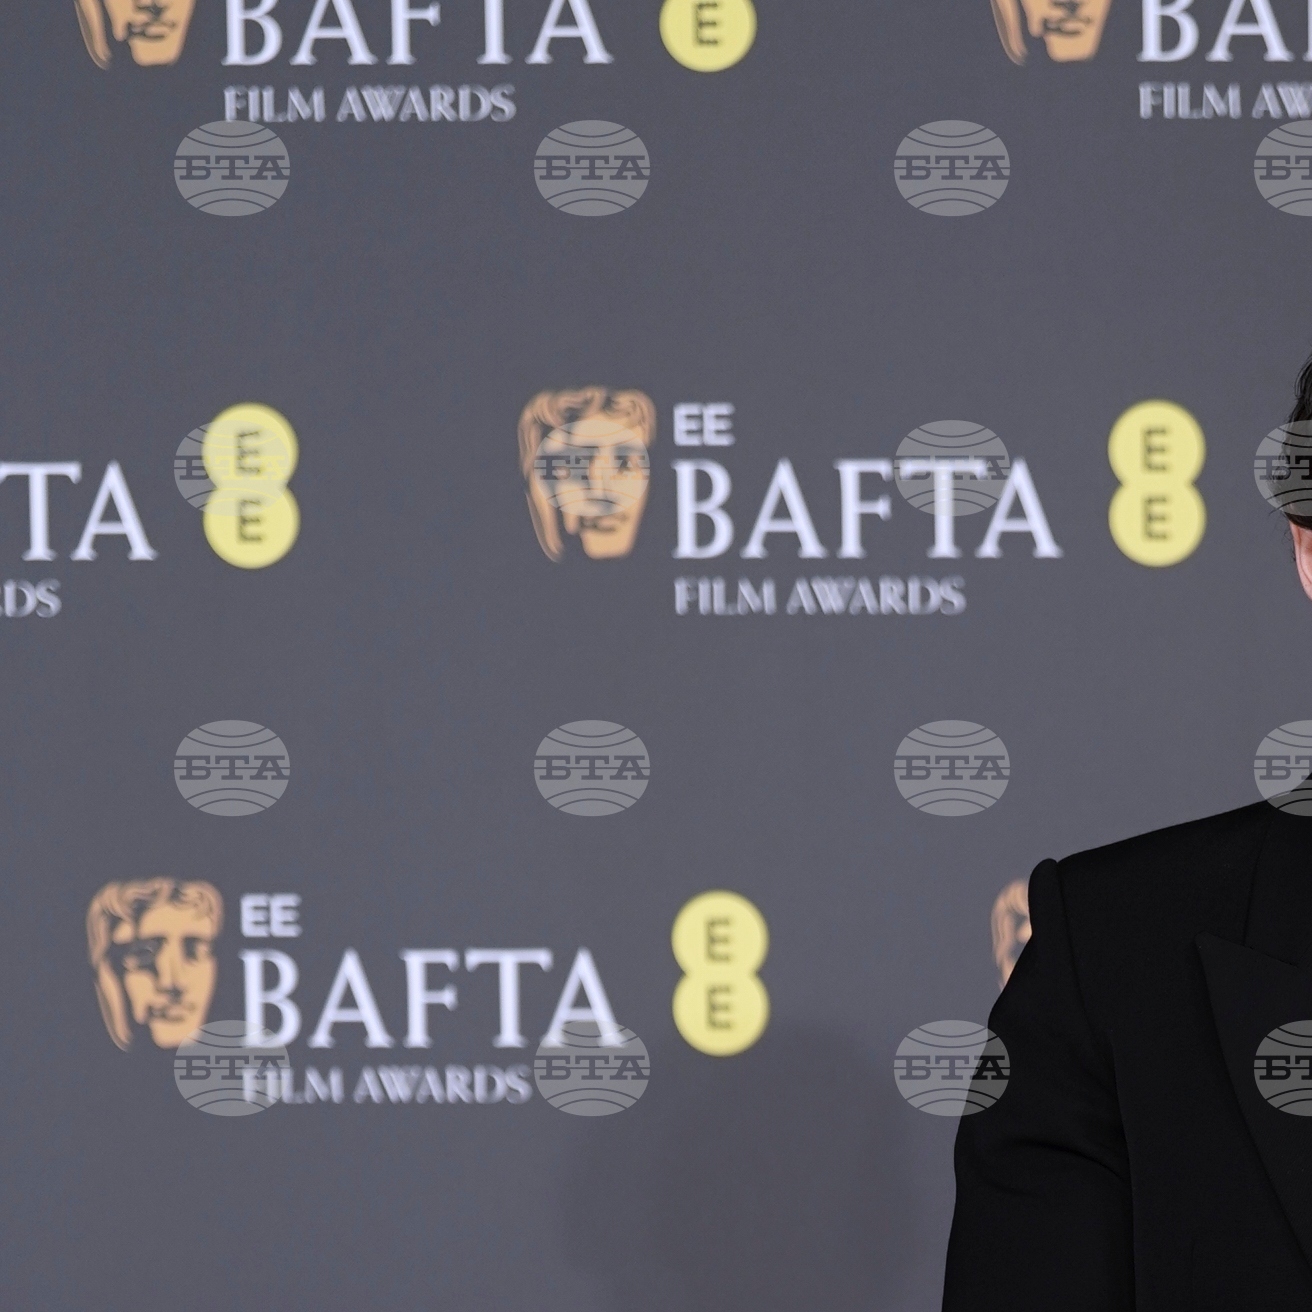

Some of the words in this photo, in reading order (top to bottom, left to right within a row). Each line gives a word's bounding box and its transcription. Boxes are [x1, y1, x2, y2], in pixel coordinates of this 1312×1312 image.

[224, 85, 325, 122] FILM
[337, 84, 516, 122] AWARDS
[1139, 82, 1239, 119] FILM
[673, 403, 735, 446] EE
[673, 457, 1064, 559] BAFTA
[673, 577, 777, 615] FILM
[786, 576, 967, 615] AWARDS
[240, 893, 300, 937] EE
[240, 947, 627, 1049] BAFTA
[241, 1066, 343, 1104] FILM
[353, 1065, 531, 1104] AWARDS
